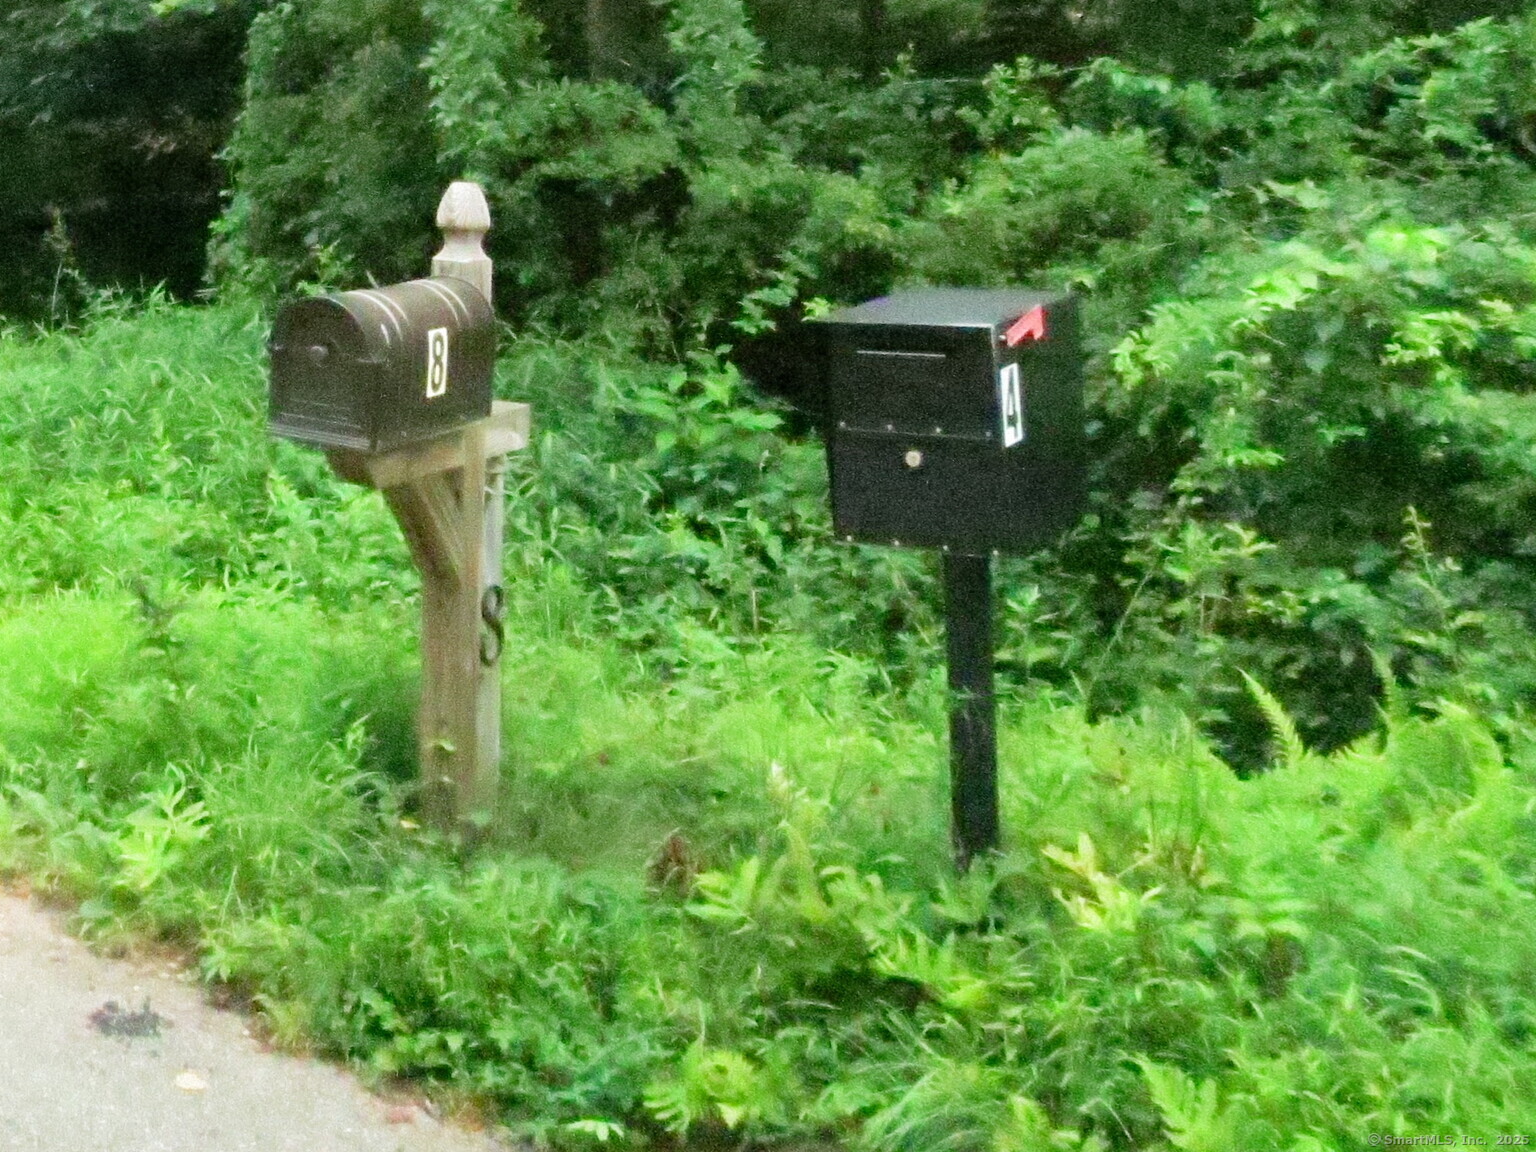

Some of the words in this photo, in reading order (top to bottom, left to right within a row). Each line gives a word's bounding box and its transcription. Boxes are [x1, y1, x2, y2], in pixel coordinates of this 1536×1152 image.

[429, 331, 445, 393] 8
[1005, 366, 1020, 440] 4
[480, 584, 504, 667] 8
